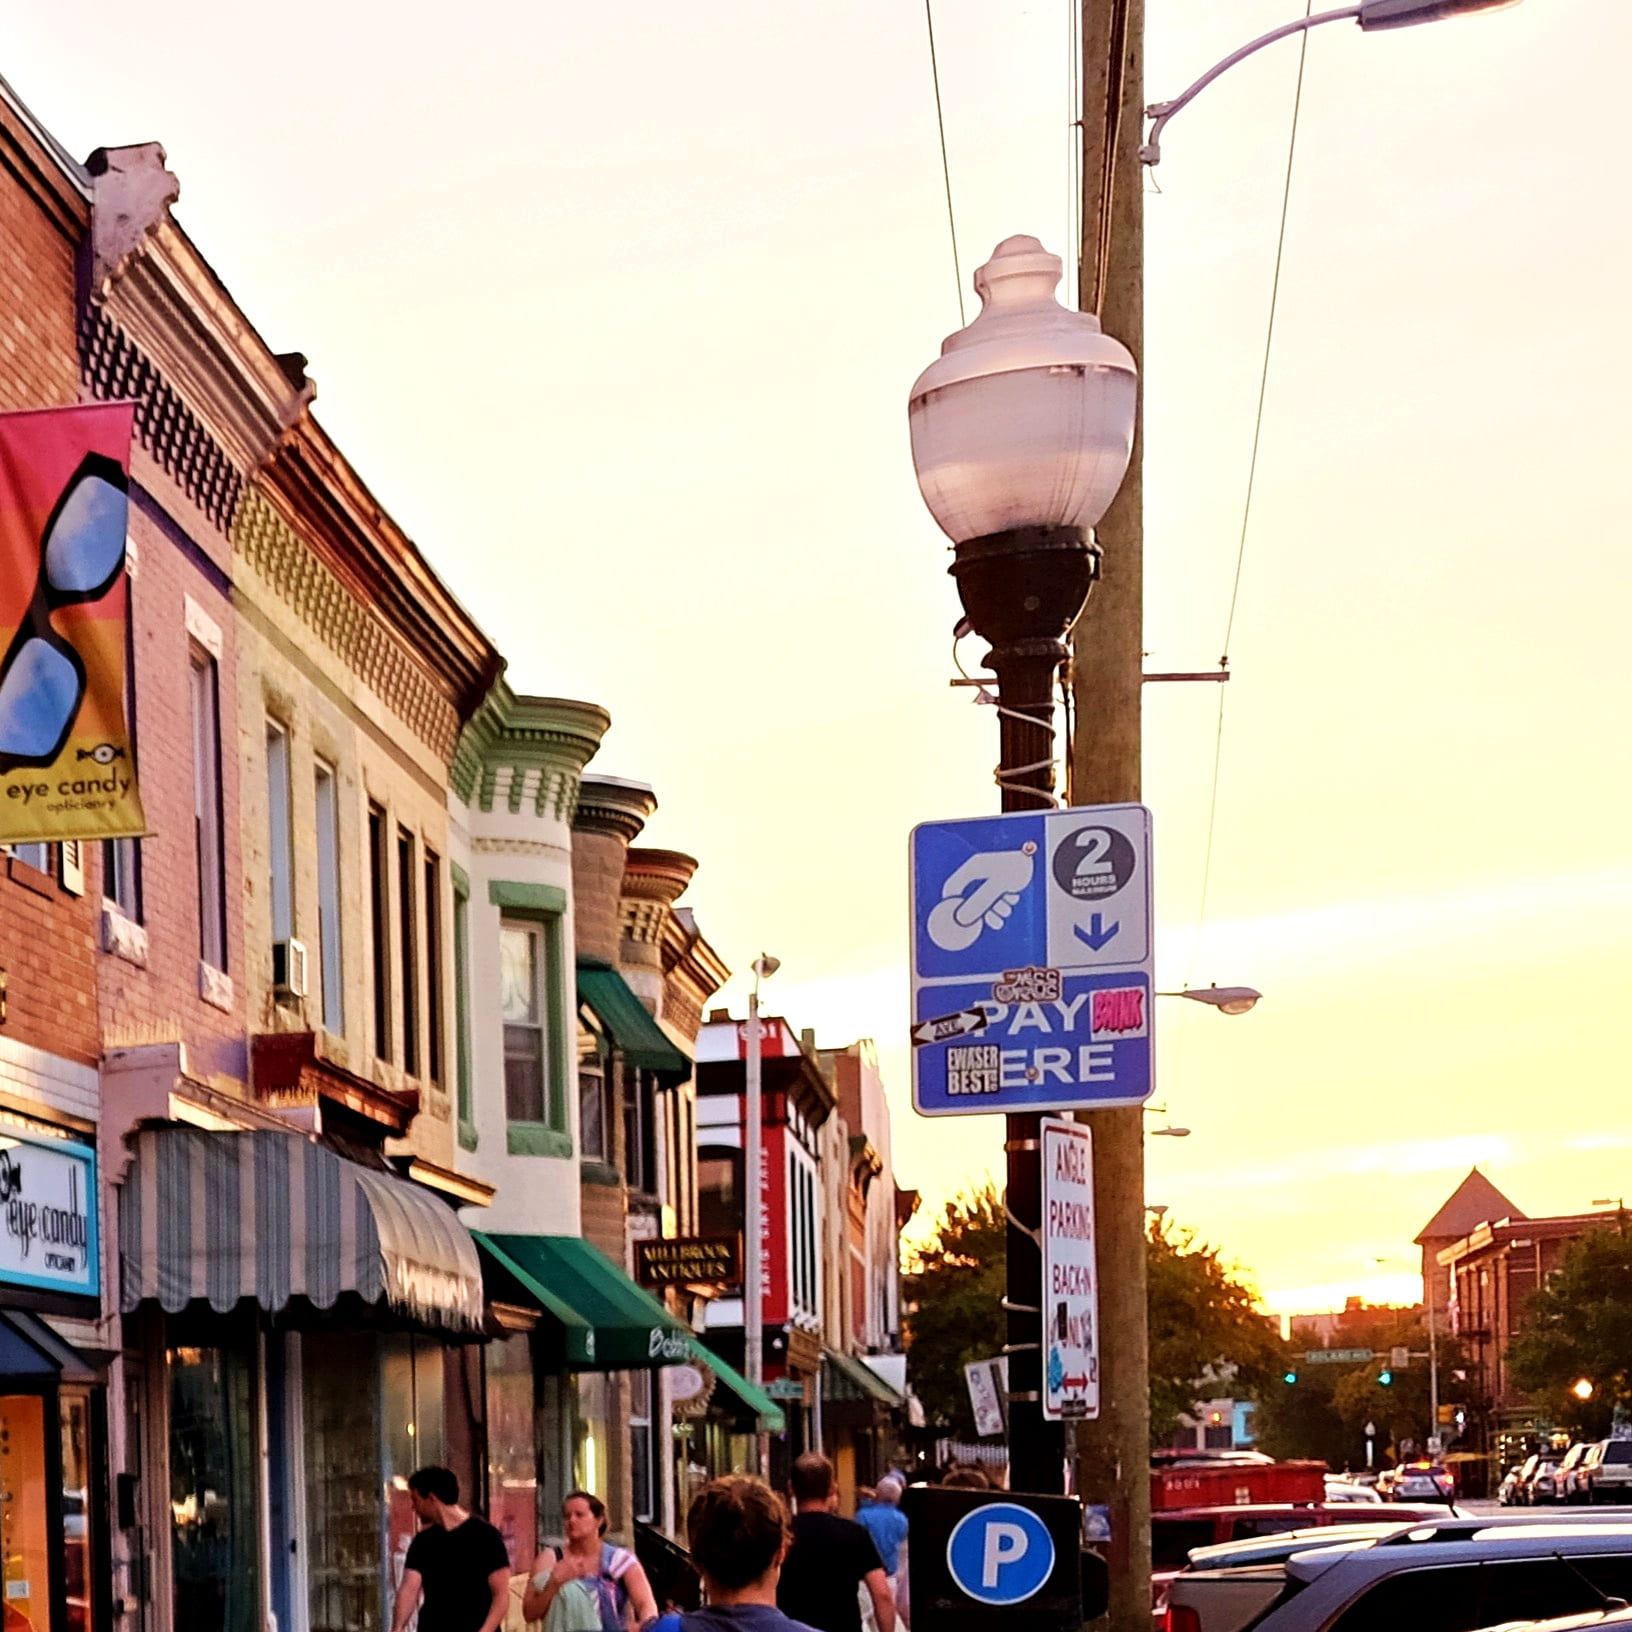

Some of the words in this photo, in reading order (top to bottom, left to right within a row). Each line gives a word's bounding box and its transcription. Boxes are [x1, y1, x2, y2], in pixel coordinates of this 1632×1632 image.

[6, 783, 49, 805] eye
[57, 766, 130, 799] candy
[1075, 829, 1113, 876] 2
[1071, 874, 1116, 887] HOURS
[973, 994, 1089, 1038] PAY
[999, 1044, 1116, 1088] ERE
[1055, 1142, 1087, 1185] ANGLE
[7, 1198, 38, 1258] eye
[40, 1163, 88, 1270] candy
[1049, 1200, 1091, 1240] PARKING
[649, 1261, 727, 1279] ANTIQUES
[981, 1521, 1029, 1588] P
